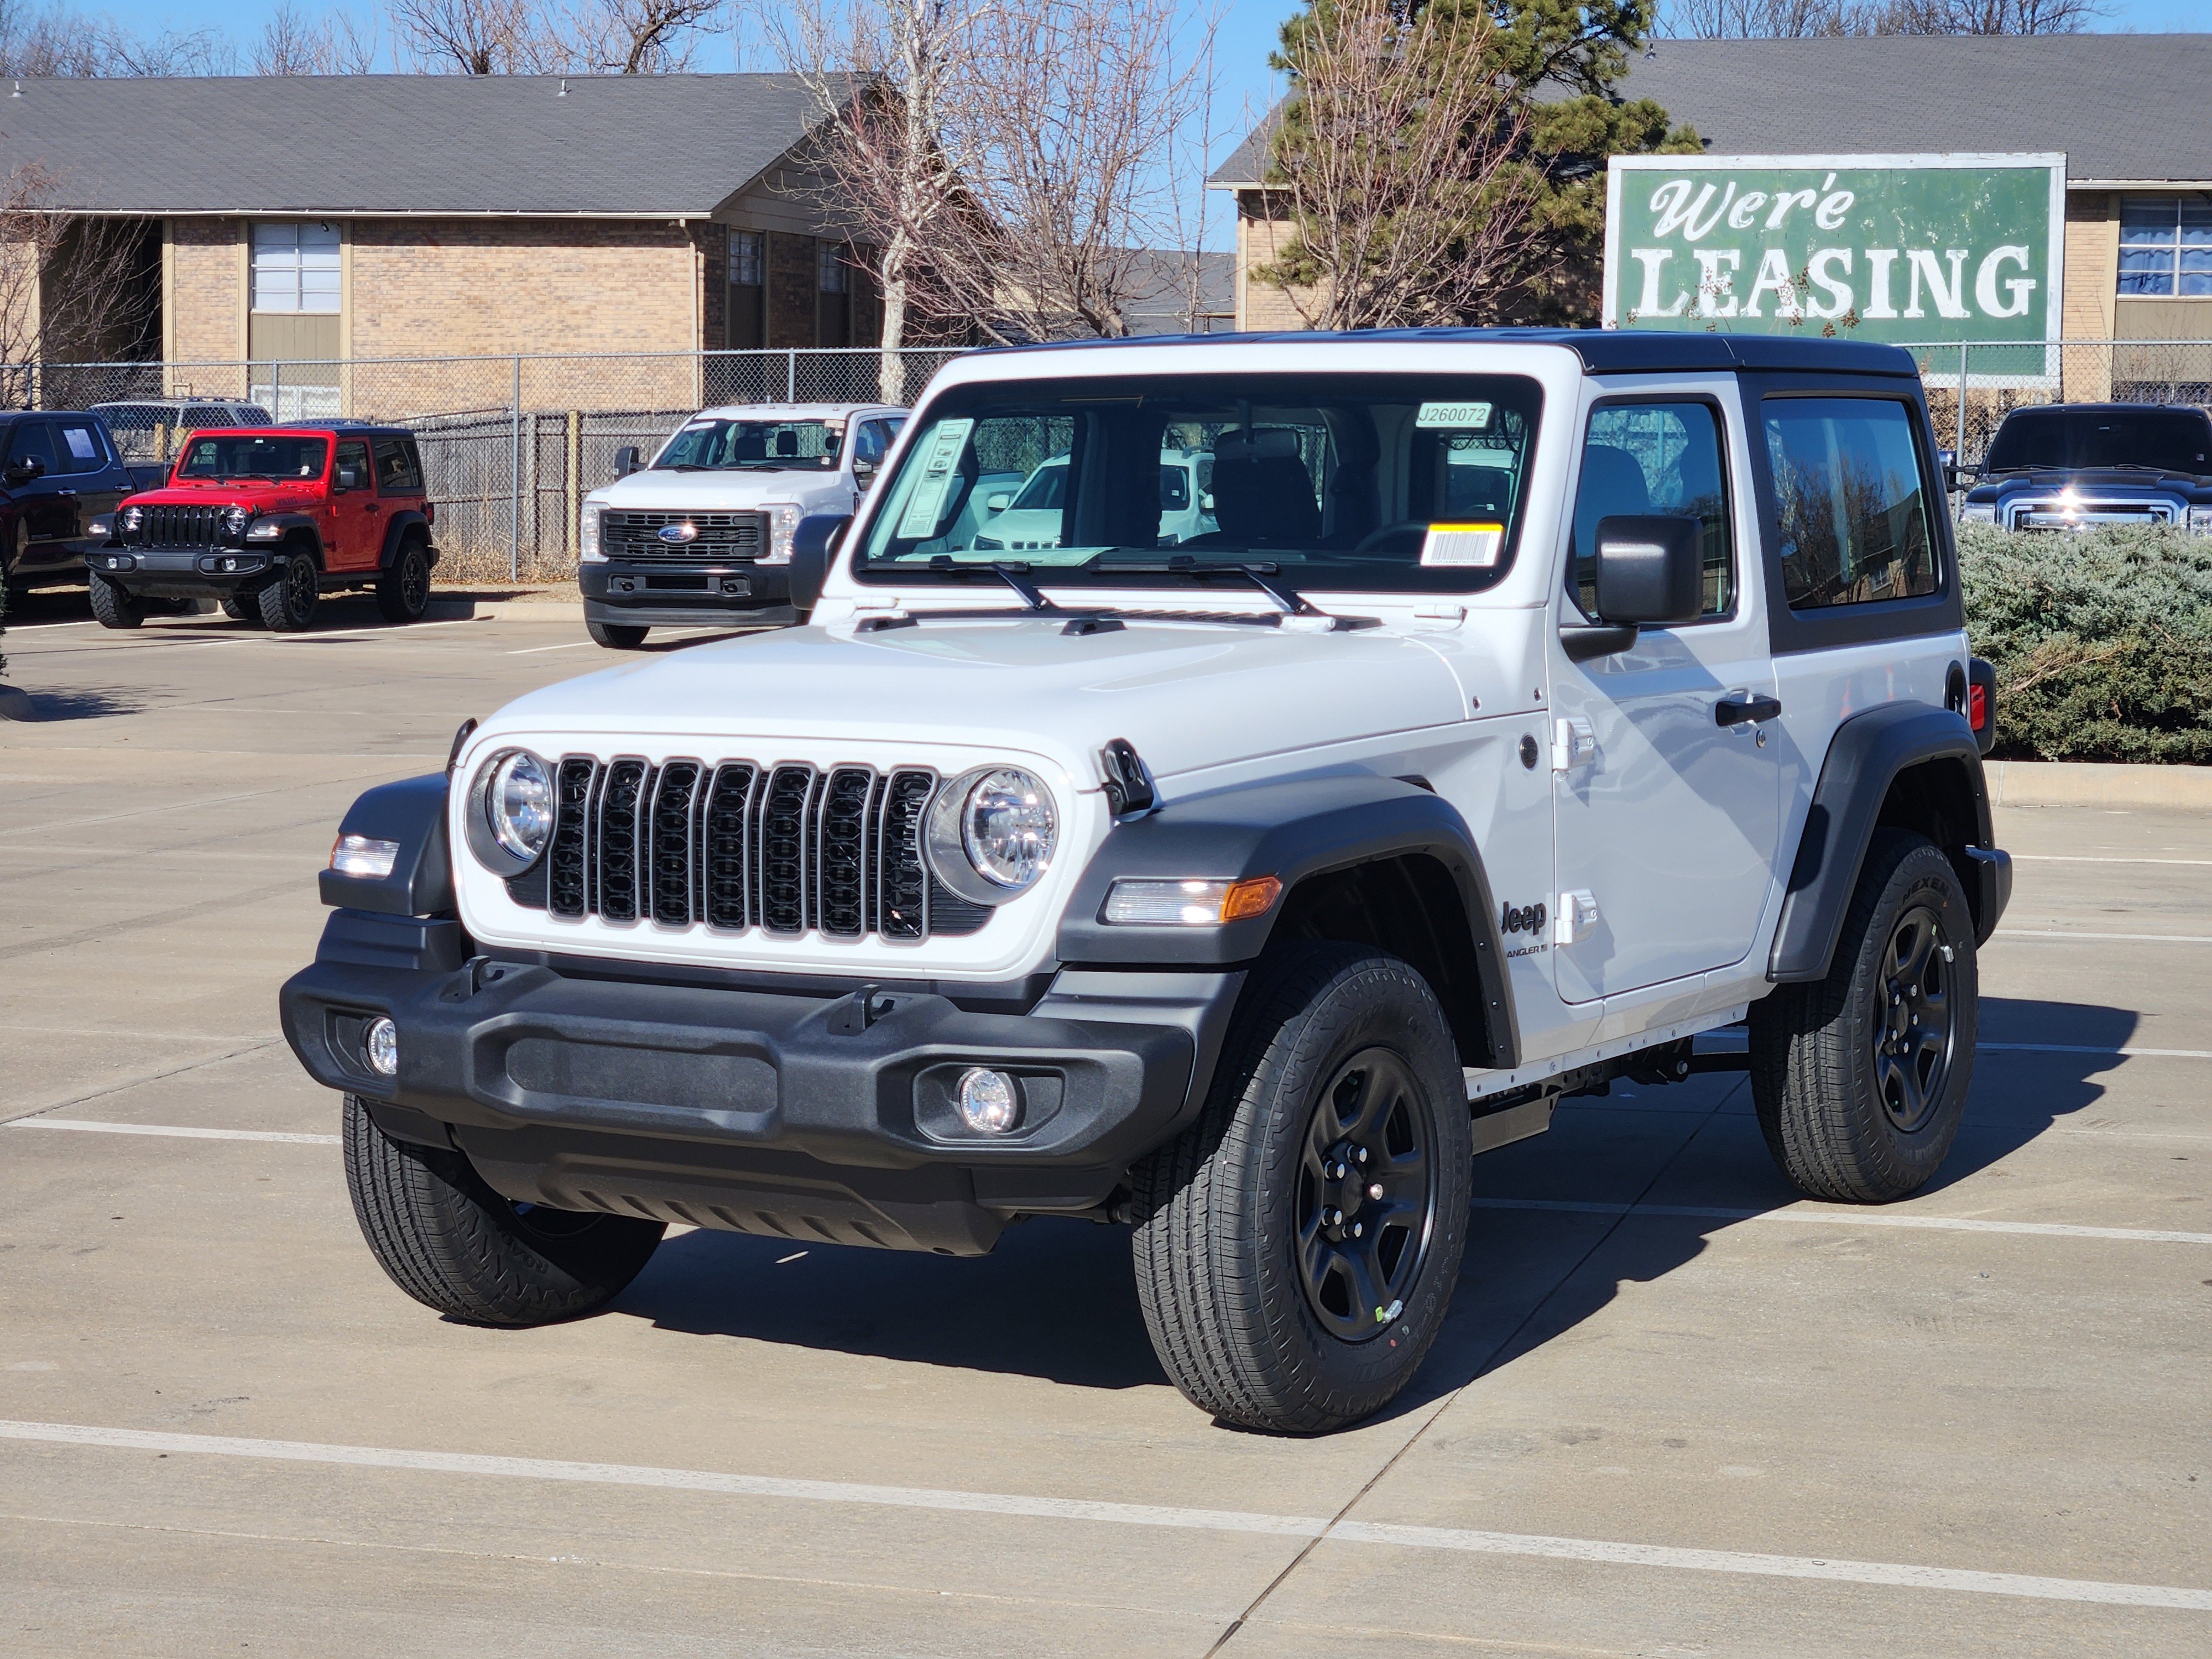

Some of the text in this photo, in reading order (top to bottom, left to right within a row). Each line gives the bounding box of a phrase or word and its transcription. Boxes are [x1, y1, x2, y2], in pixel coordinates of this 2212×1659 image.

[1631, 245, 2037, 320] LEASING
[1418, 408, 1486, 421] J260072
[1501, 900, 1547, 936] Jeep
[1507, 945, 1540, 958] ANGLER
